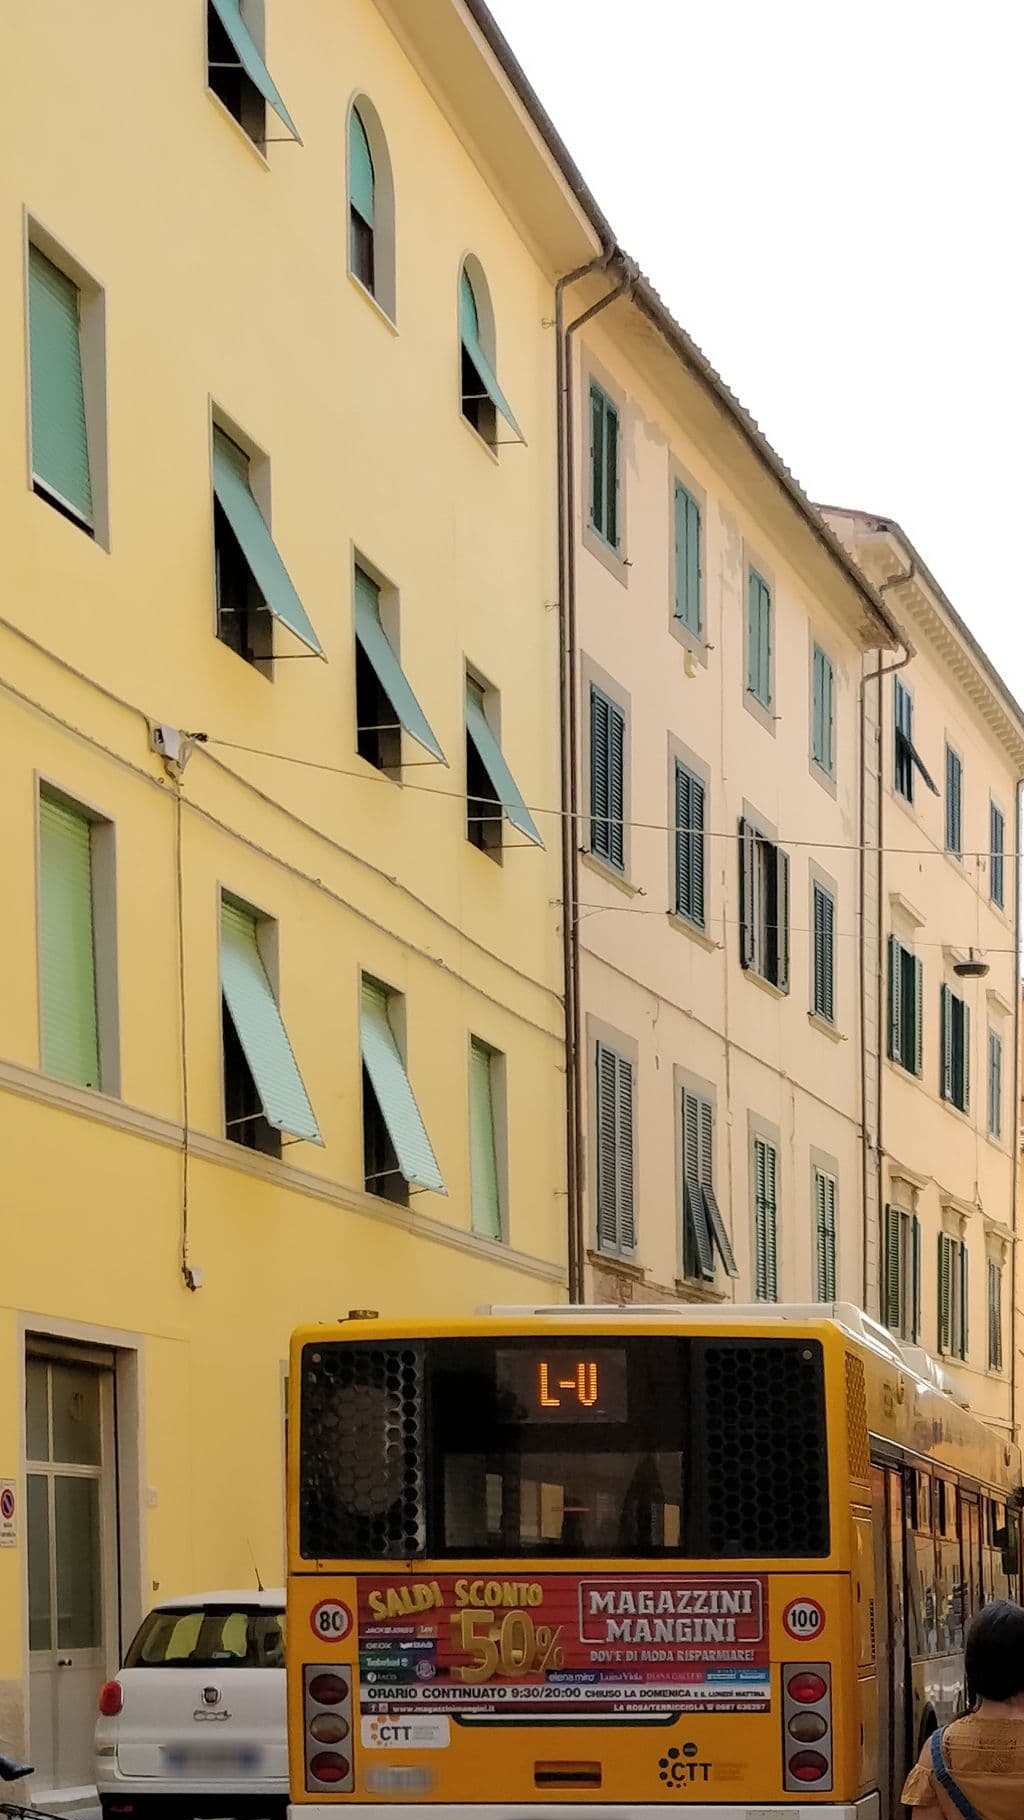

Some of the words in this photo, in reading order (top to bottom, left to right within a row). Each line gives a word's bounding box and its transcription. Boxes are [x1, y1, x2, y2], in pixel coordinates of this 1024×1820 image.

[540, 1362, 598, 1407] L-U
[368, 1580, 445, 1621] SALDI
[454, 1578, 545, 1607] SCONTO
[588, 1590, 753, 1615] MAGAZZINI
[319, 1610, 344, 1632] 80
[790, 1609, 819, 1628] 100
[606, 1618, 737, 1643] MANGINI
[452, 1609, 565, 1684] 50%
[625, 1650, 638, 1662] DI
[641, 1650, 674, 1662] MODA
[677, 1650, 754, 1662] RISPARMIARE!
[368, 1687, 417, 1699] ORARIO
[422, 1687, 507, 1699] CONTINUATO
[511, 1687, 581, 1699] 9:30/20:00
[584, 1688, 621, 1699] CHIUSO
[624, 1688, 636, 1698] LA
[639, 1688, 691, 1698] DOMENICA
[392, 1704, 495, 1713] www.magazzinimangini.it
[613, 1703, 625, 1712] LA
[380, 1726, 412, 1741] CTT
[671, 1762, 712, 1782] CTT
